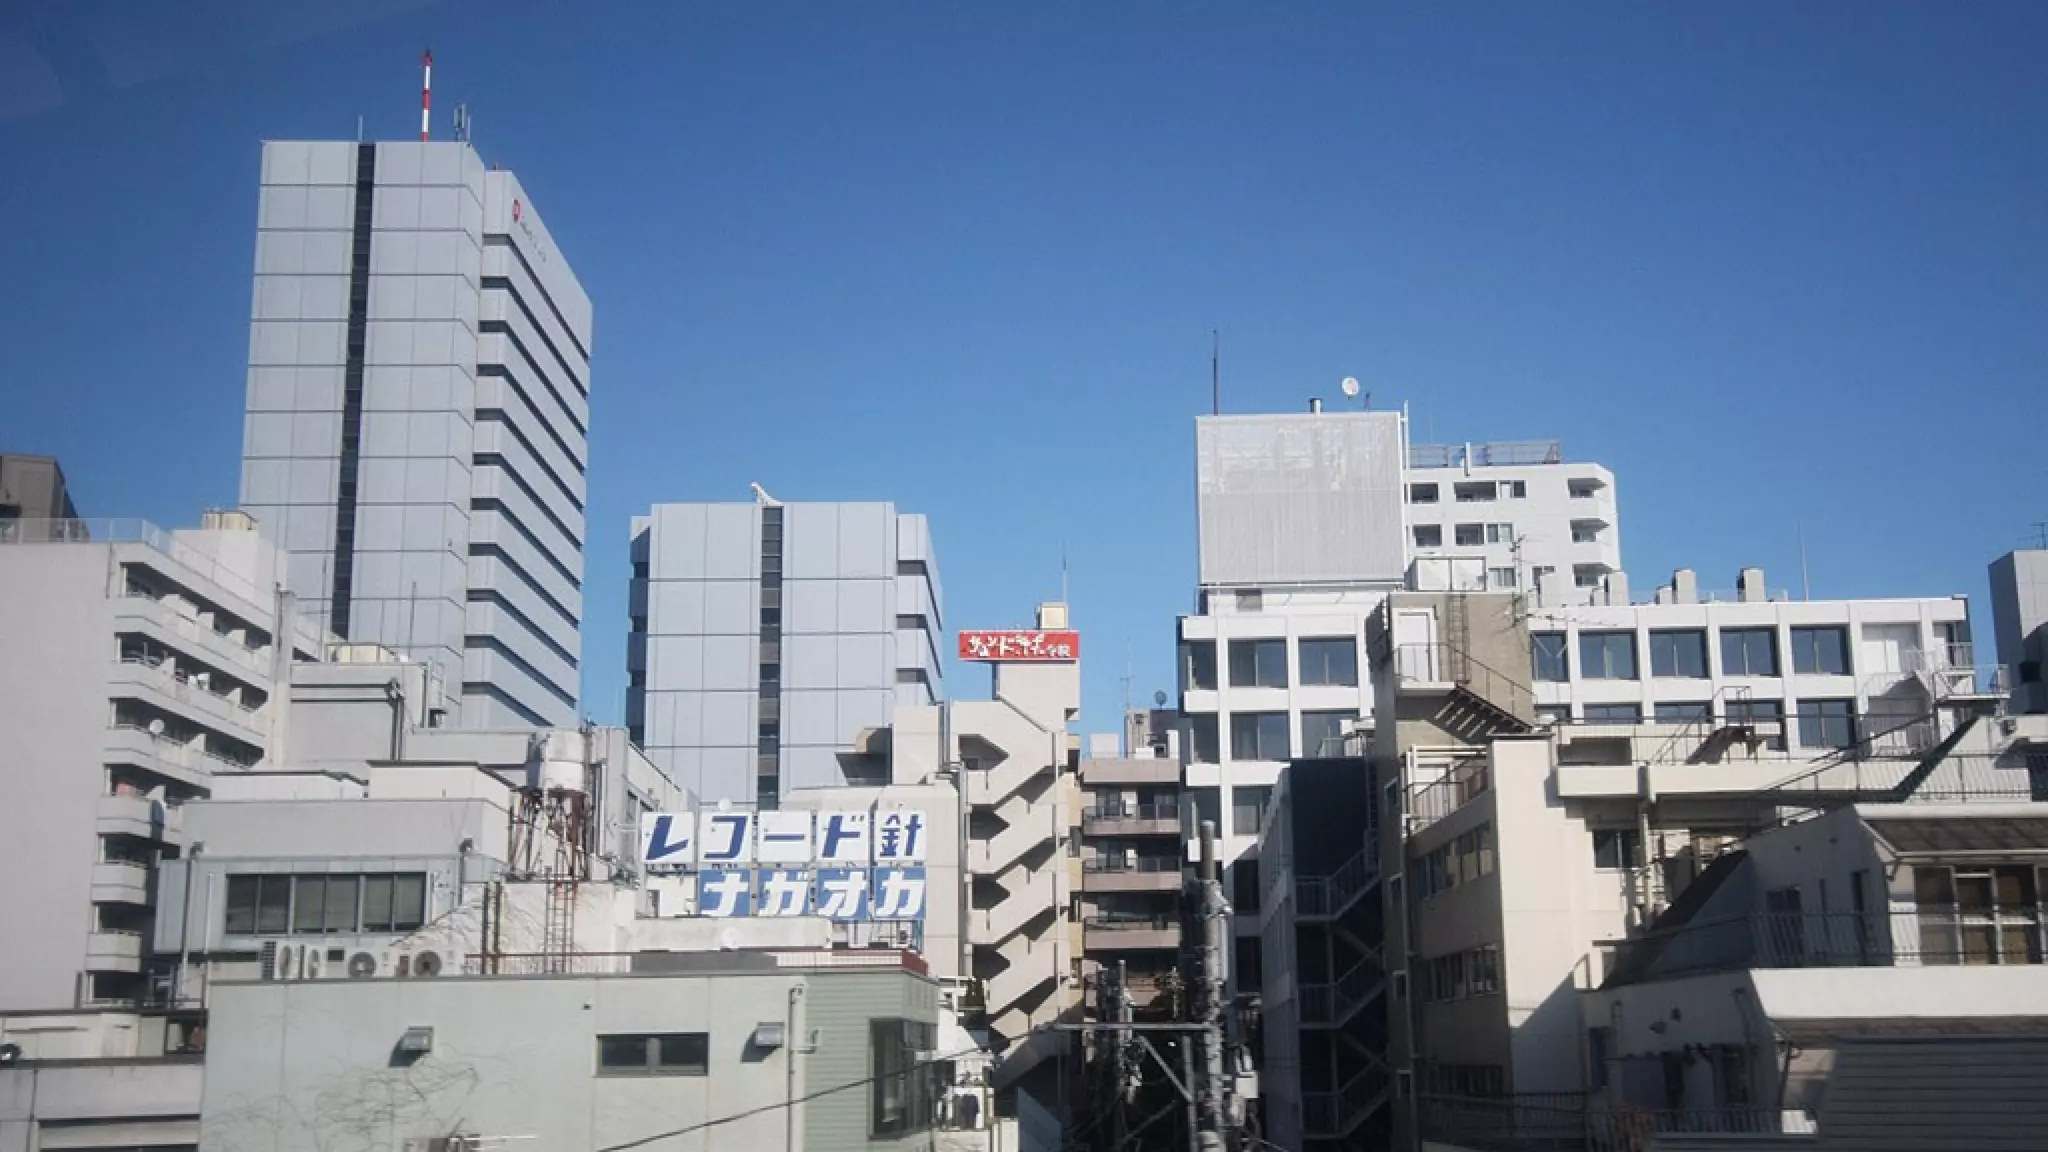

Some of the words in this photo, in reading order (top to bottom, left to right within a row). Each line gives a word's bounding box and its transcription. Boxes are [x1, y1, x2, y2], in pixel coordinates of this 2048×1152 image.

[645, 814, 922, 860] レコード針
[701, 871, 924, 917] ナガオカ
